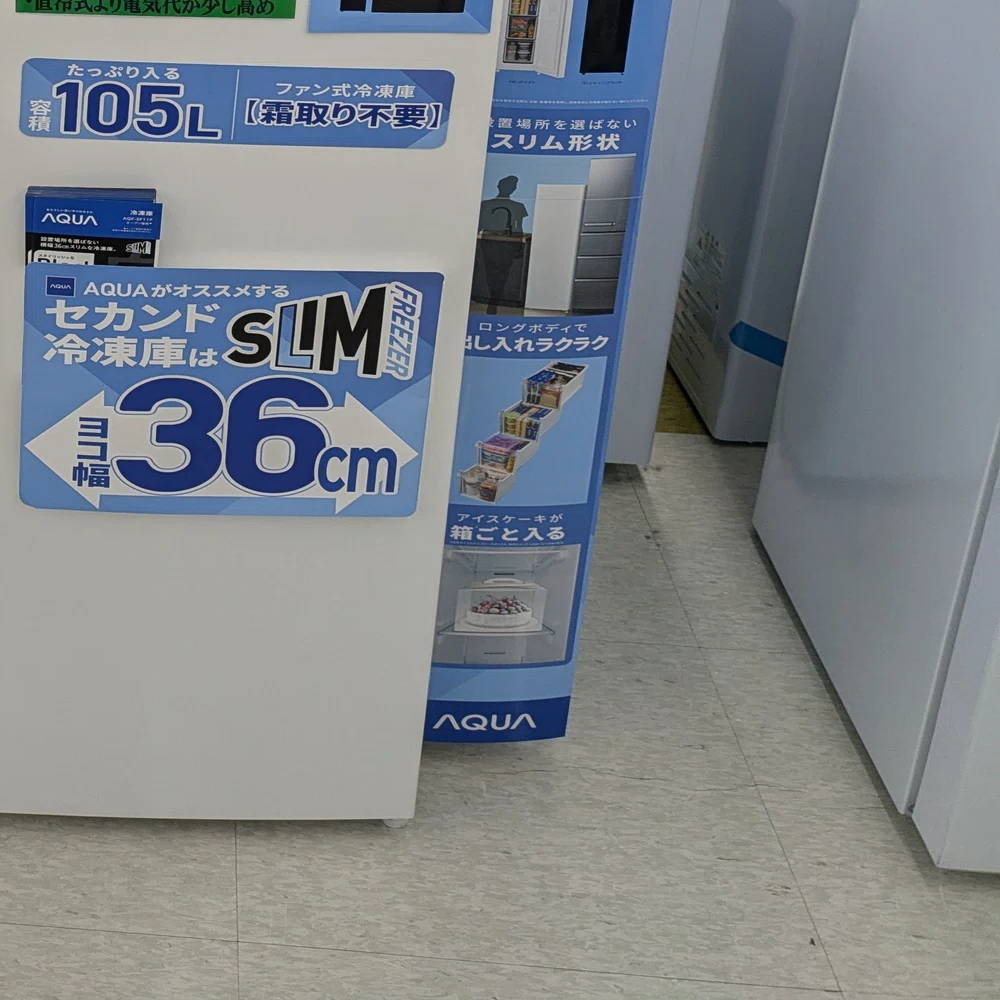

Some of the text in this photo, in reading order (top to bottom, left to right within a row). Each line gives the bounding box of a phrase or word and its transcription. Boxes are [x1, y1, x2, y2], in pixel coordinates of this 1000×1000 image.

[66, 63, 181, 81] たっぷり入る
[275, 82, 416, 100] ファン式冷凍庫
[28, 80, 223, 141] 容積 105L
[243, 99, 442, 131] 【霜取り不要】
[491, 133, 621, 152] スリム形状
[41, 212, 99, 226] AQUA
[49, 281, 290, 300] AQUA AQUAがオススメする
[44, 299, 221, 333] セカンド
[226, 282, 421, 380] SLIM FREEZER
[479, 322, 588, 334] ロングボディで
[42, 333, 219, 368] 冷凍庫は
[71, 376, 399, 496] ヨコ幅 36cm
[457, 513, 563, 525] アイスケーキが
[450, 525, 566, 542] 箱ごと入る
[432, 713, 537, 731] AQUA
